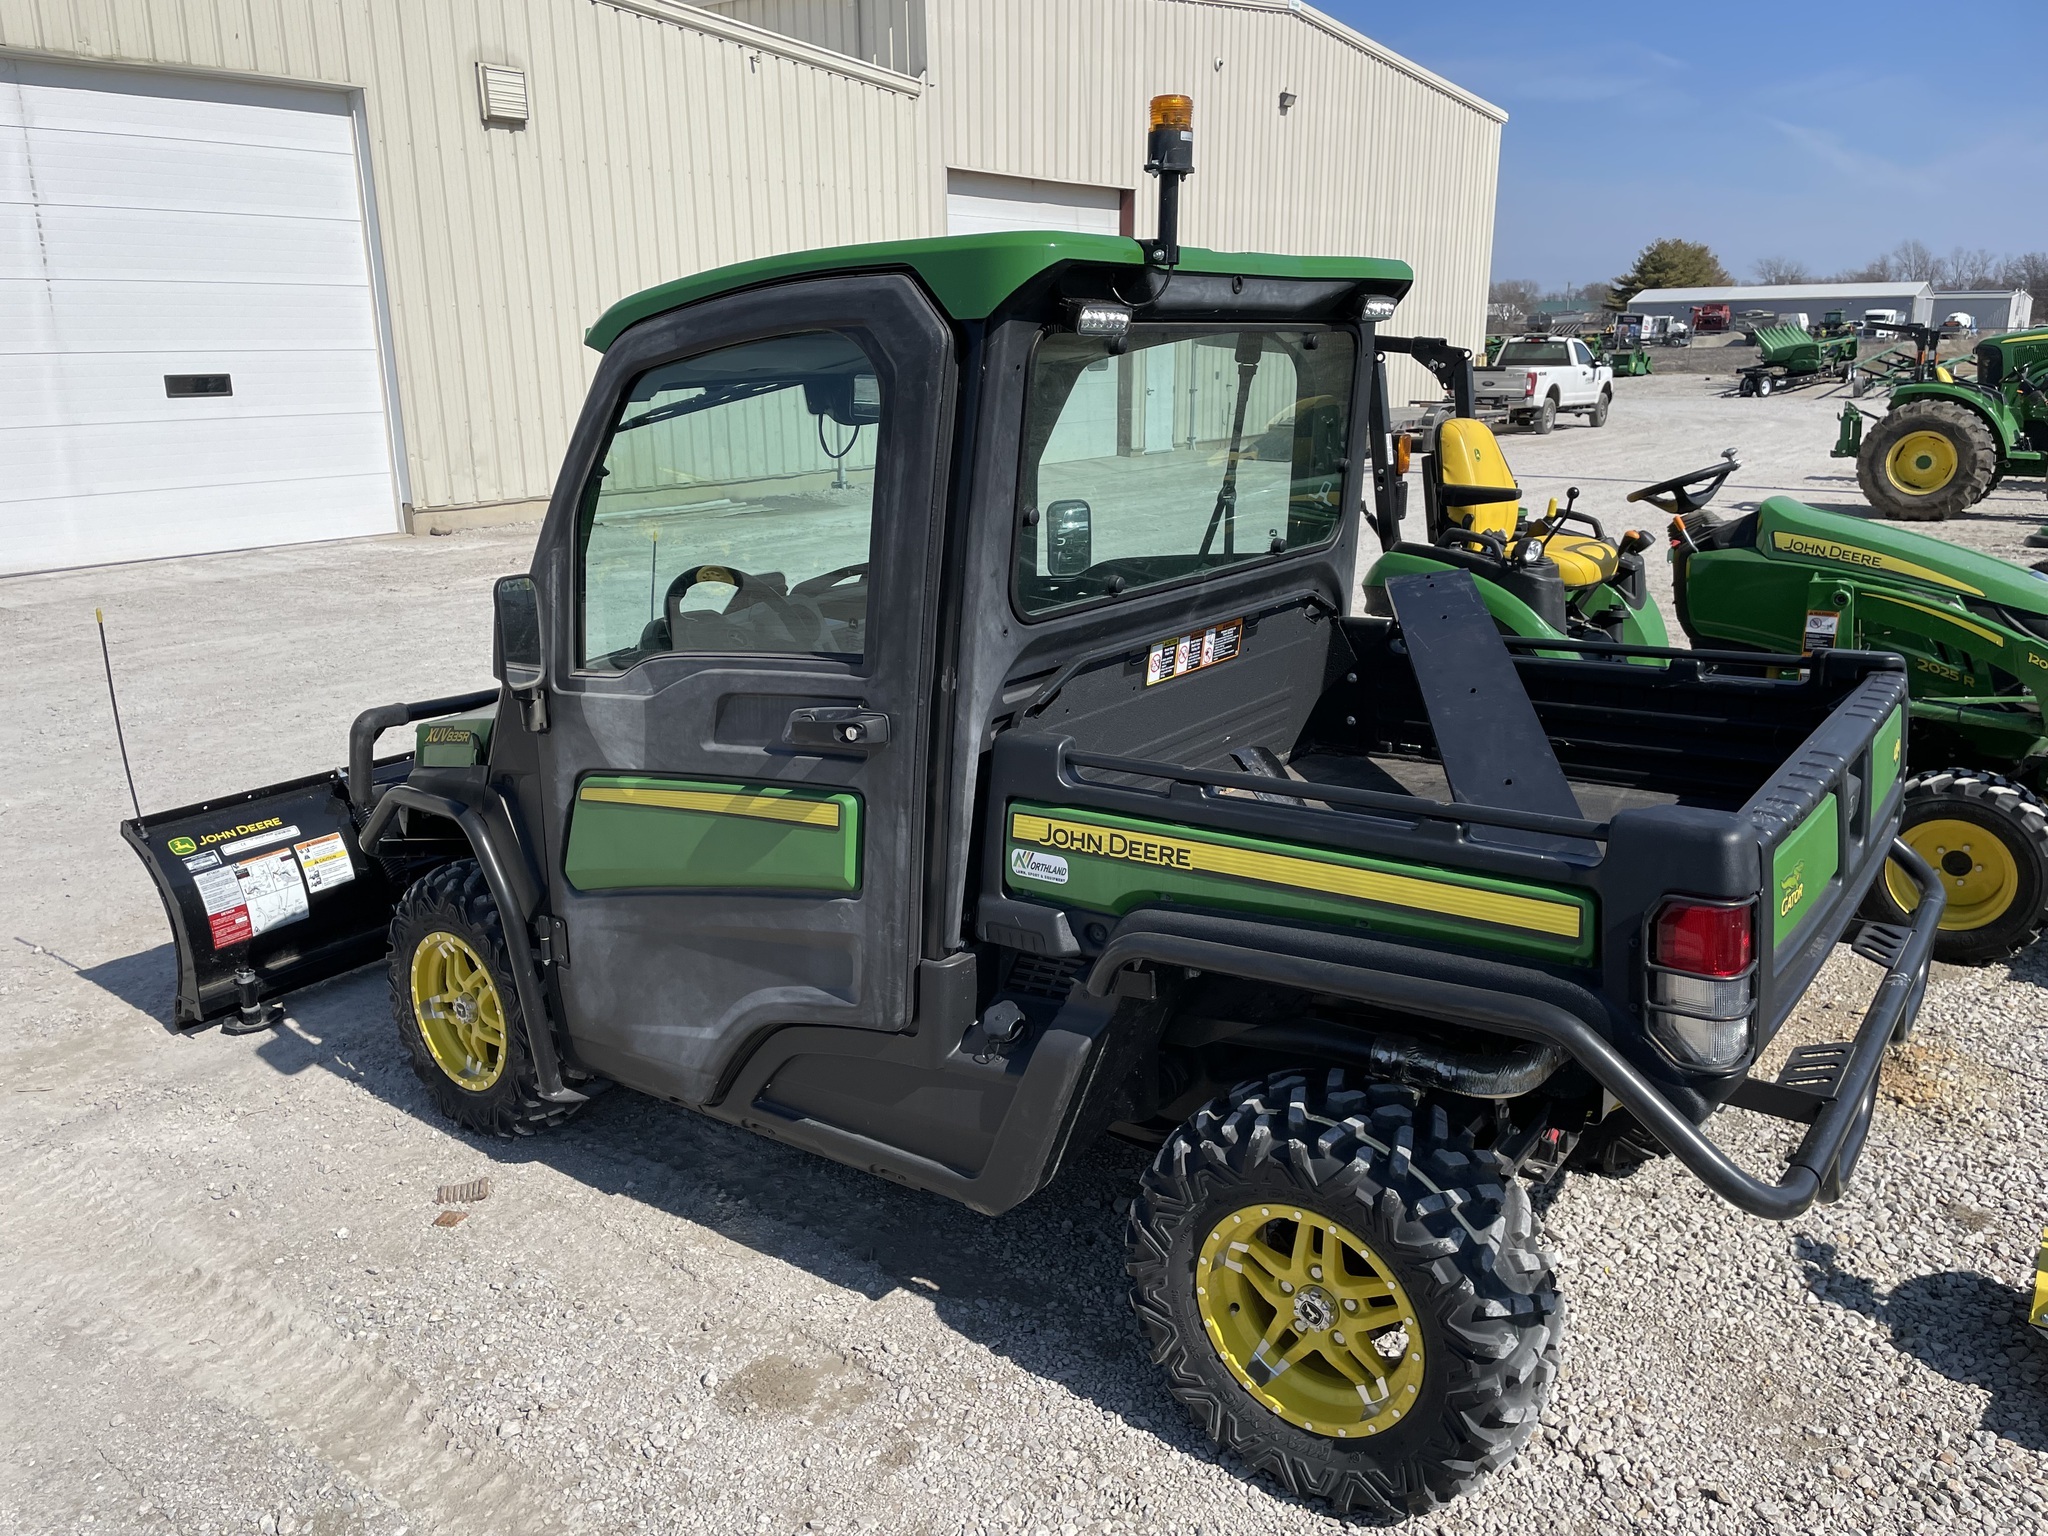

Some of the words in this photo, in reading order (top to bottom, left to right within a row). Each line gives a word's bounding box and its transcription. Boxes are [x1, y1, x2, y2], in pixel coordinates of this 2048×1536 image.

[1784, 538, 1827, 558] JOHN
[1828, 545, 1883, 568] DEERE
[1917, 657, 1960, 681] 2025
[2028, 651, 2048, 669] 120
[199, 829, 238, 847] JOHN
[235, 817, 283, 835] DEERE
[1039, 822, 1102, 854] JOHN
[1109, 833, 1191, 867] DEERE
[1013, 850, 1067, 876] NORTHLAND
[1781, 883, 1803, 916] GATOR
